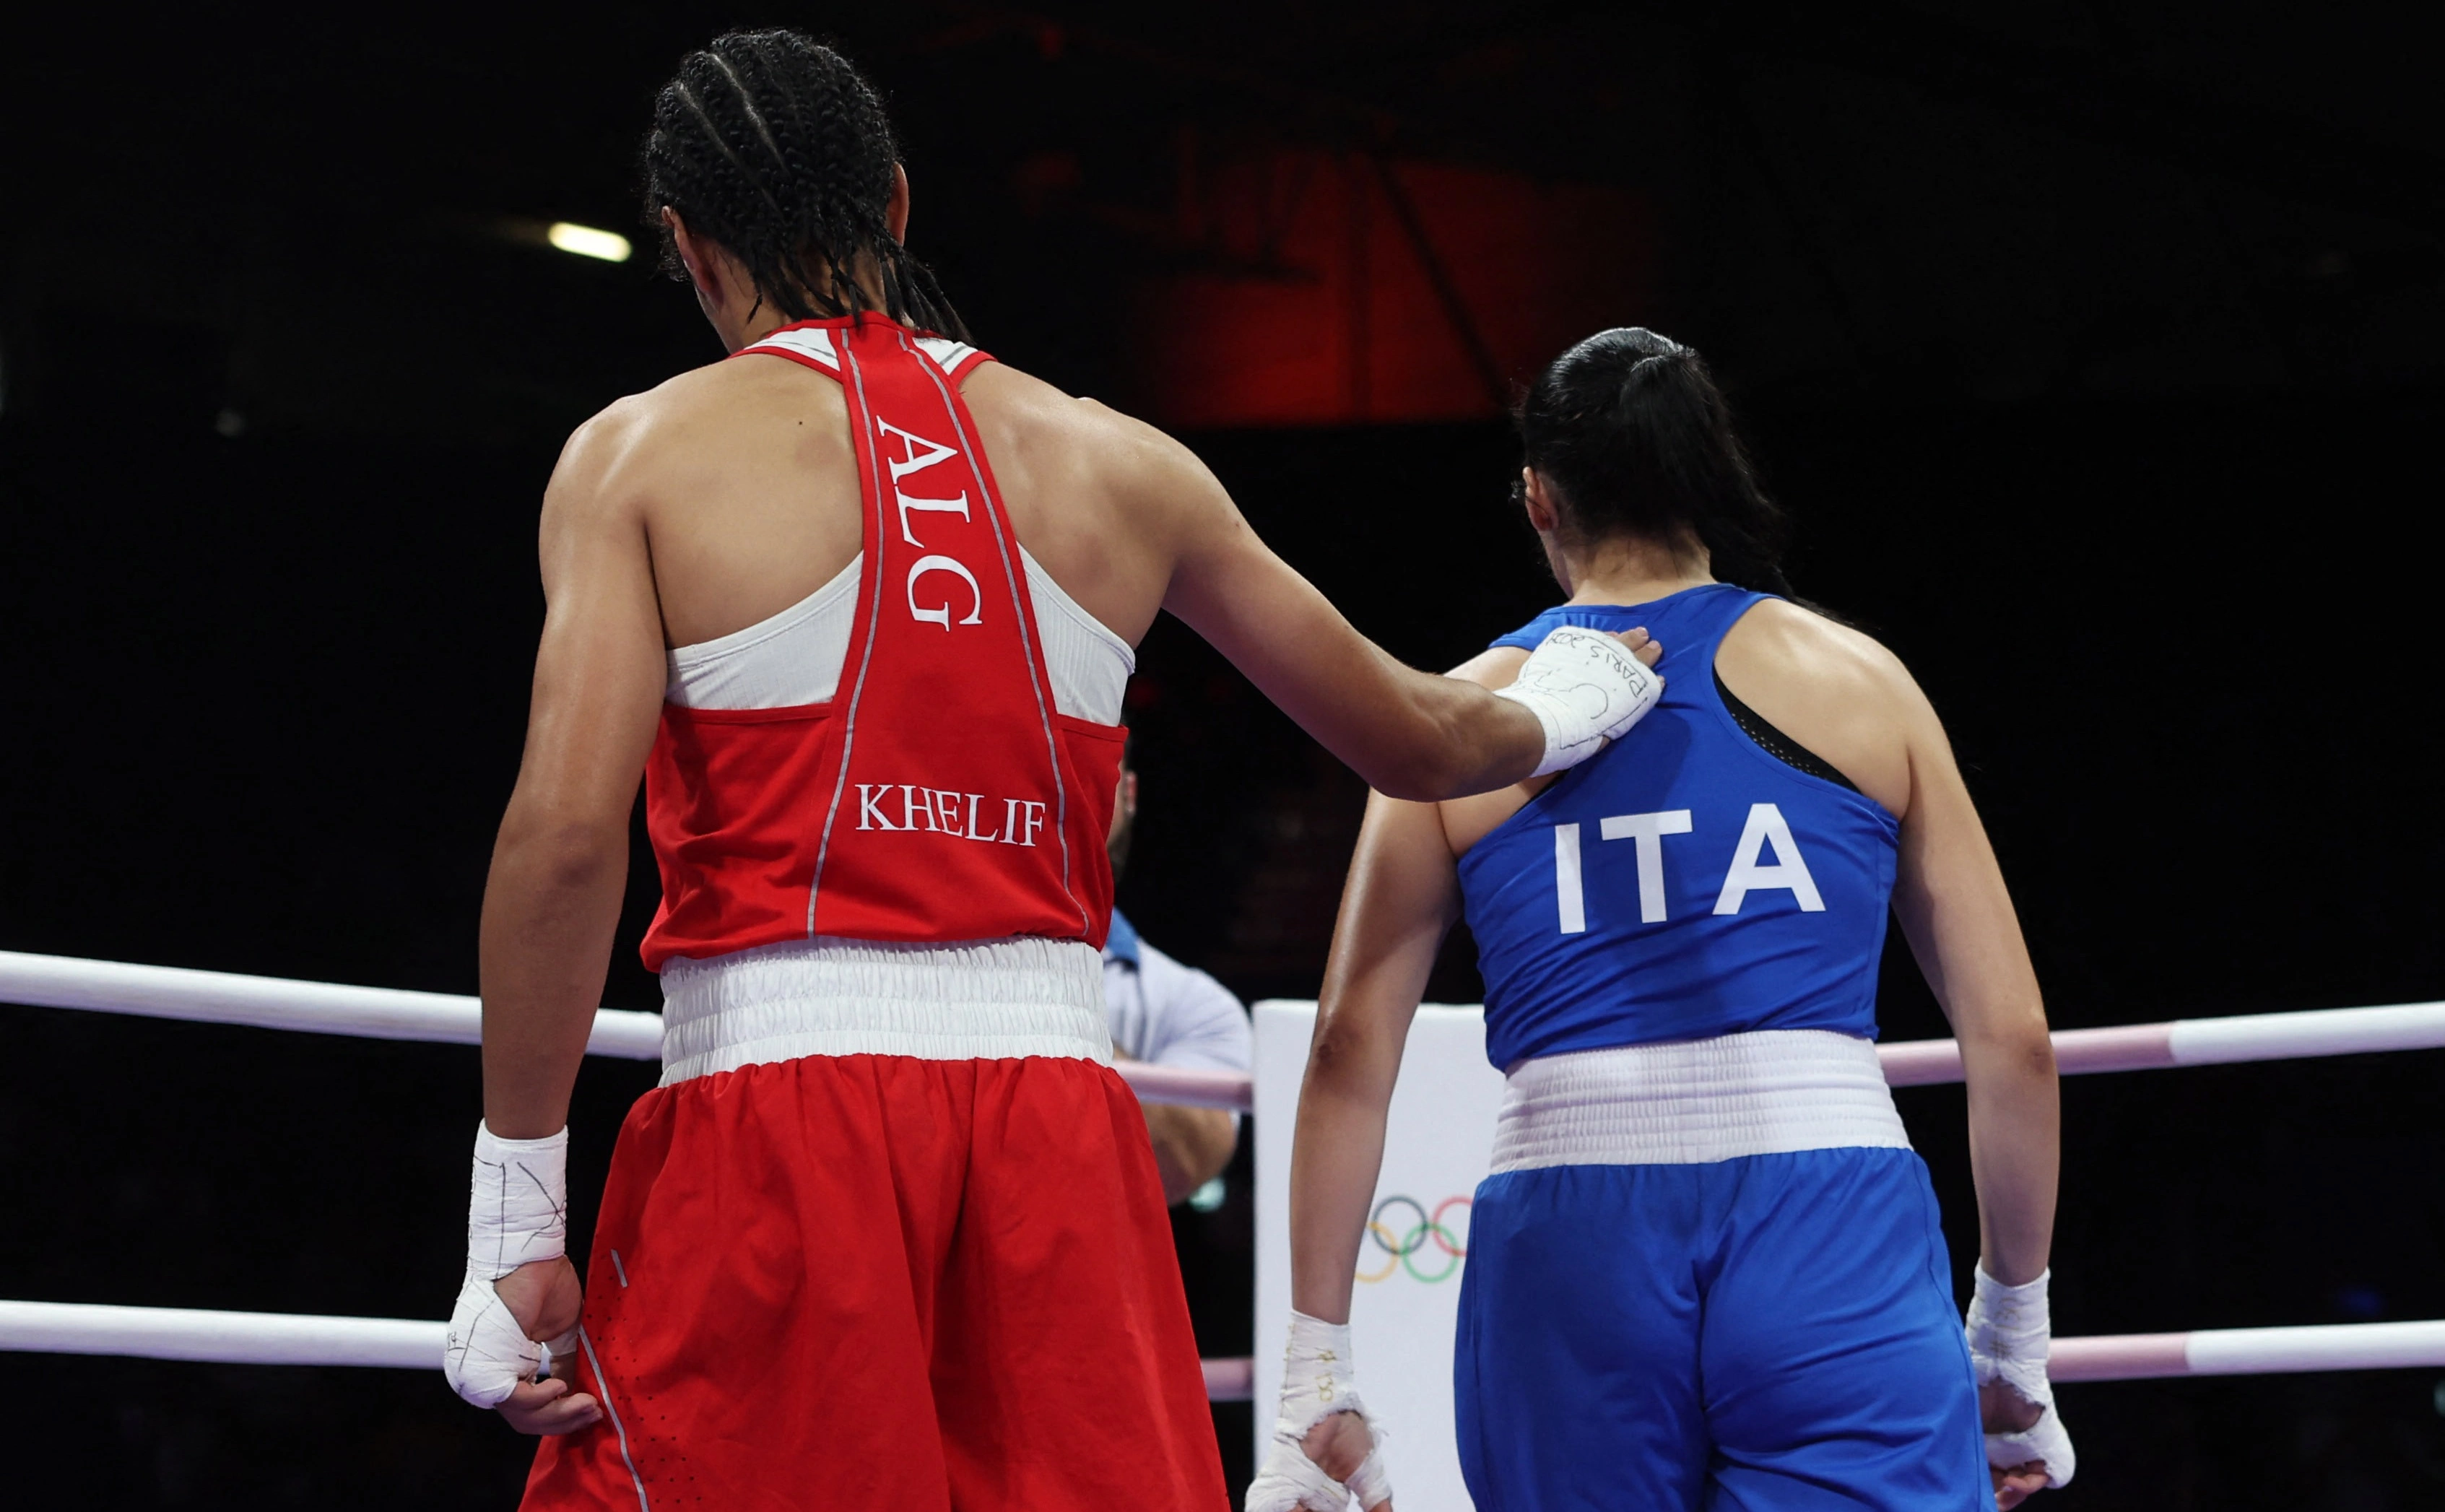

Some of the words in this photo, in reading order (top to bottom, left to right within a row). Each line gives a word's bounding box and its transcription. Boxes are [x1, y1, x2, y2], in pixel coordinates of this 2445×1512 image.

[876, 414, 983, 632] ALG
[1590, 646, 1645, 698] PARIS
[854, 784, 1046, 847] KHELIF
[1555, 803, 1826, 934] ITA
